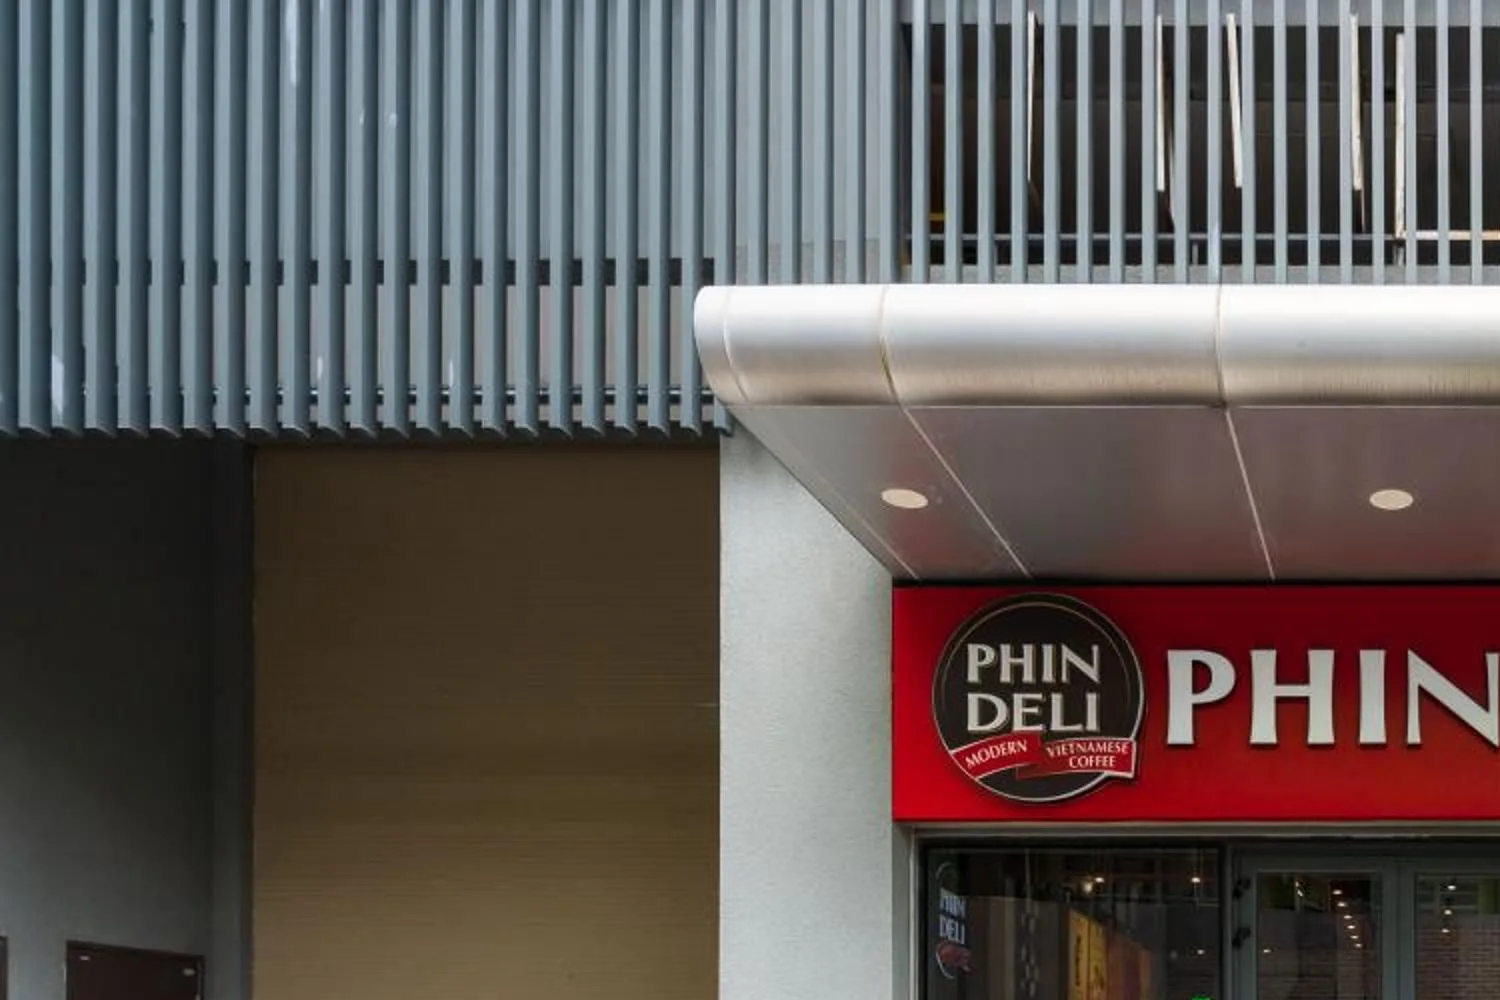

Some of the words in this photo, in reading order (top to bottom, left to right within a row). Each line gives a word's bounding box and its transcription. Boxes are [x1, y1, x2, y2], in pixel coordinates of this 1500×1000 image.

[967, 643, 1099, 684] PHIN
[967, 692, 1099, 732] DELI
[964, 739, 1028, 769] MODERN
[1045, 742, 1129, 758] VIETNAMESE
[1068, 755, 1117, 769] COFFEE
